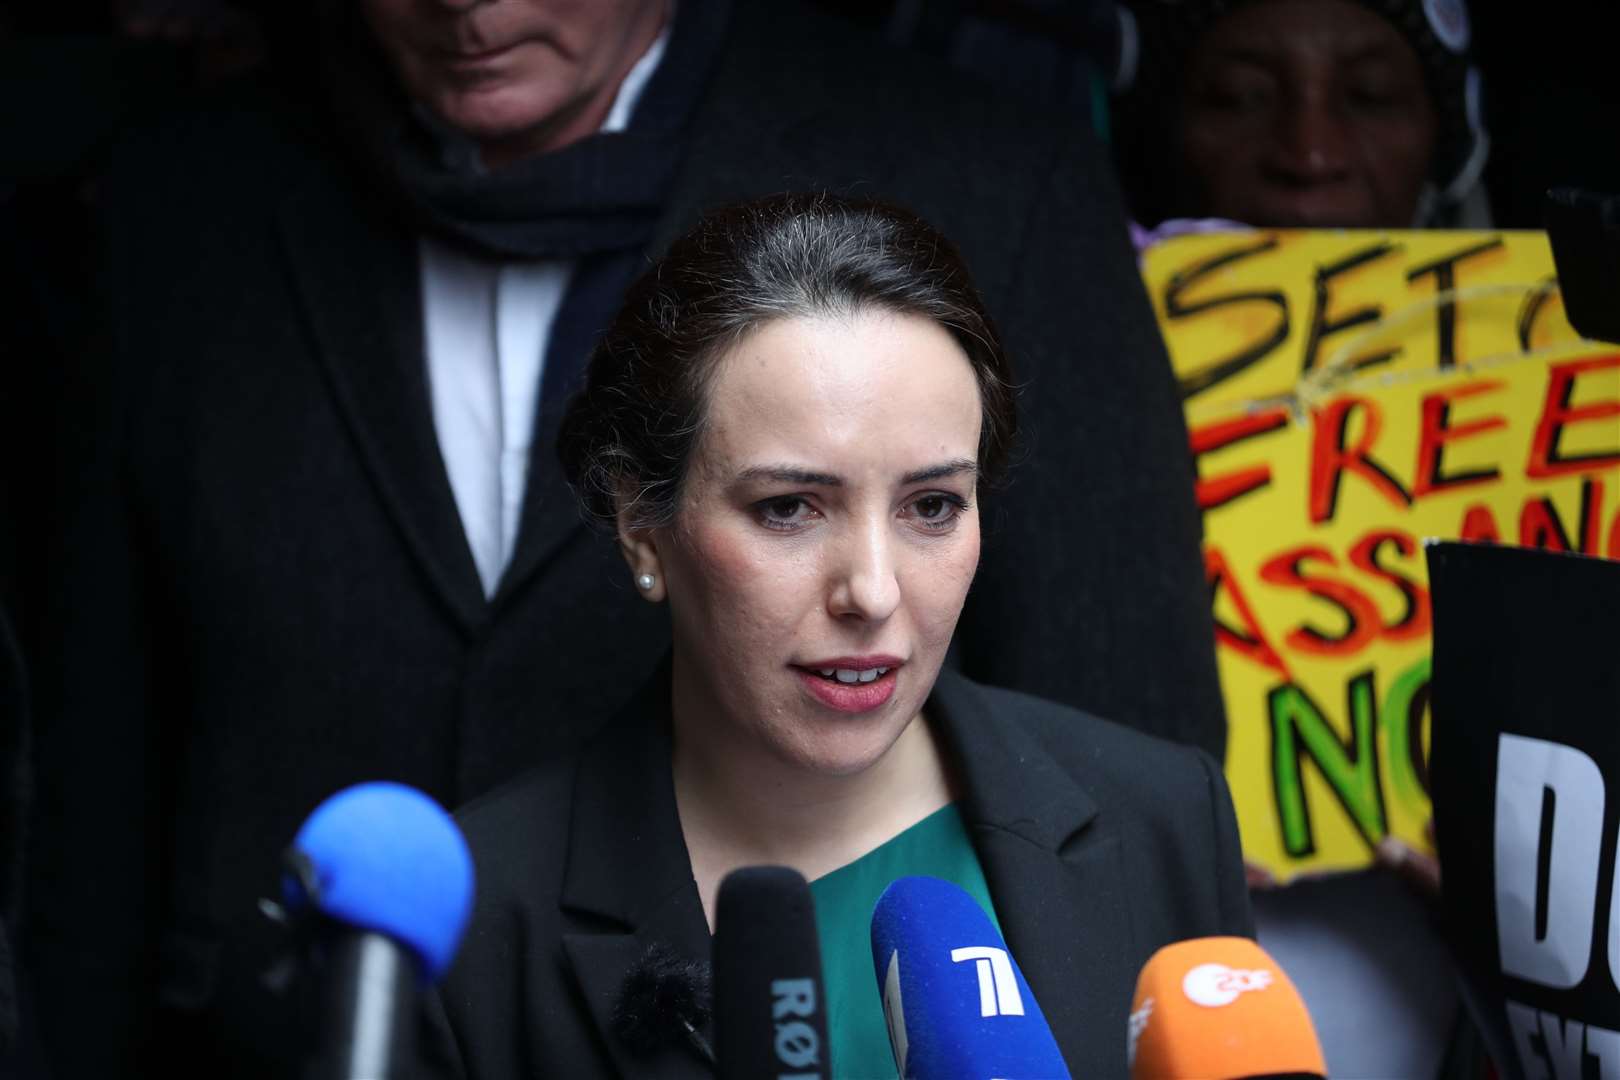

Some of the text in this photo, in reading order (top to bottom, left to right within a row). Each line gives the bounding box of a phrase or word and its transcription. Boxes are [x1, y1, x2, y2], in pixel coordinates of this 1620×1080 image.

[1165, 236, 1504, 398] SET
[1203, 478, 1620, 683] ASSN
[1495, 732, 1620, 990] D
[771, 978, 821, 1080] RØ
